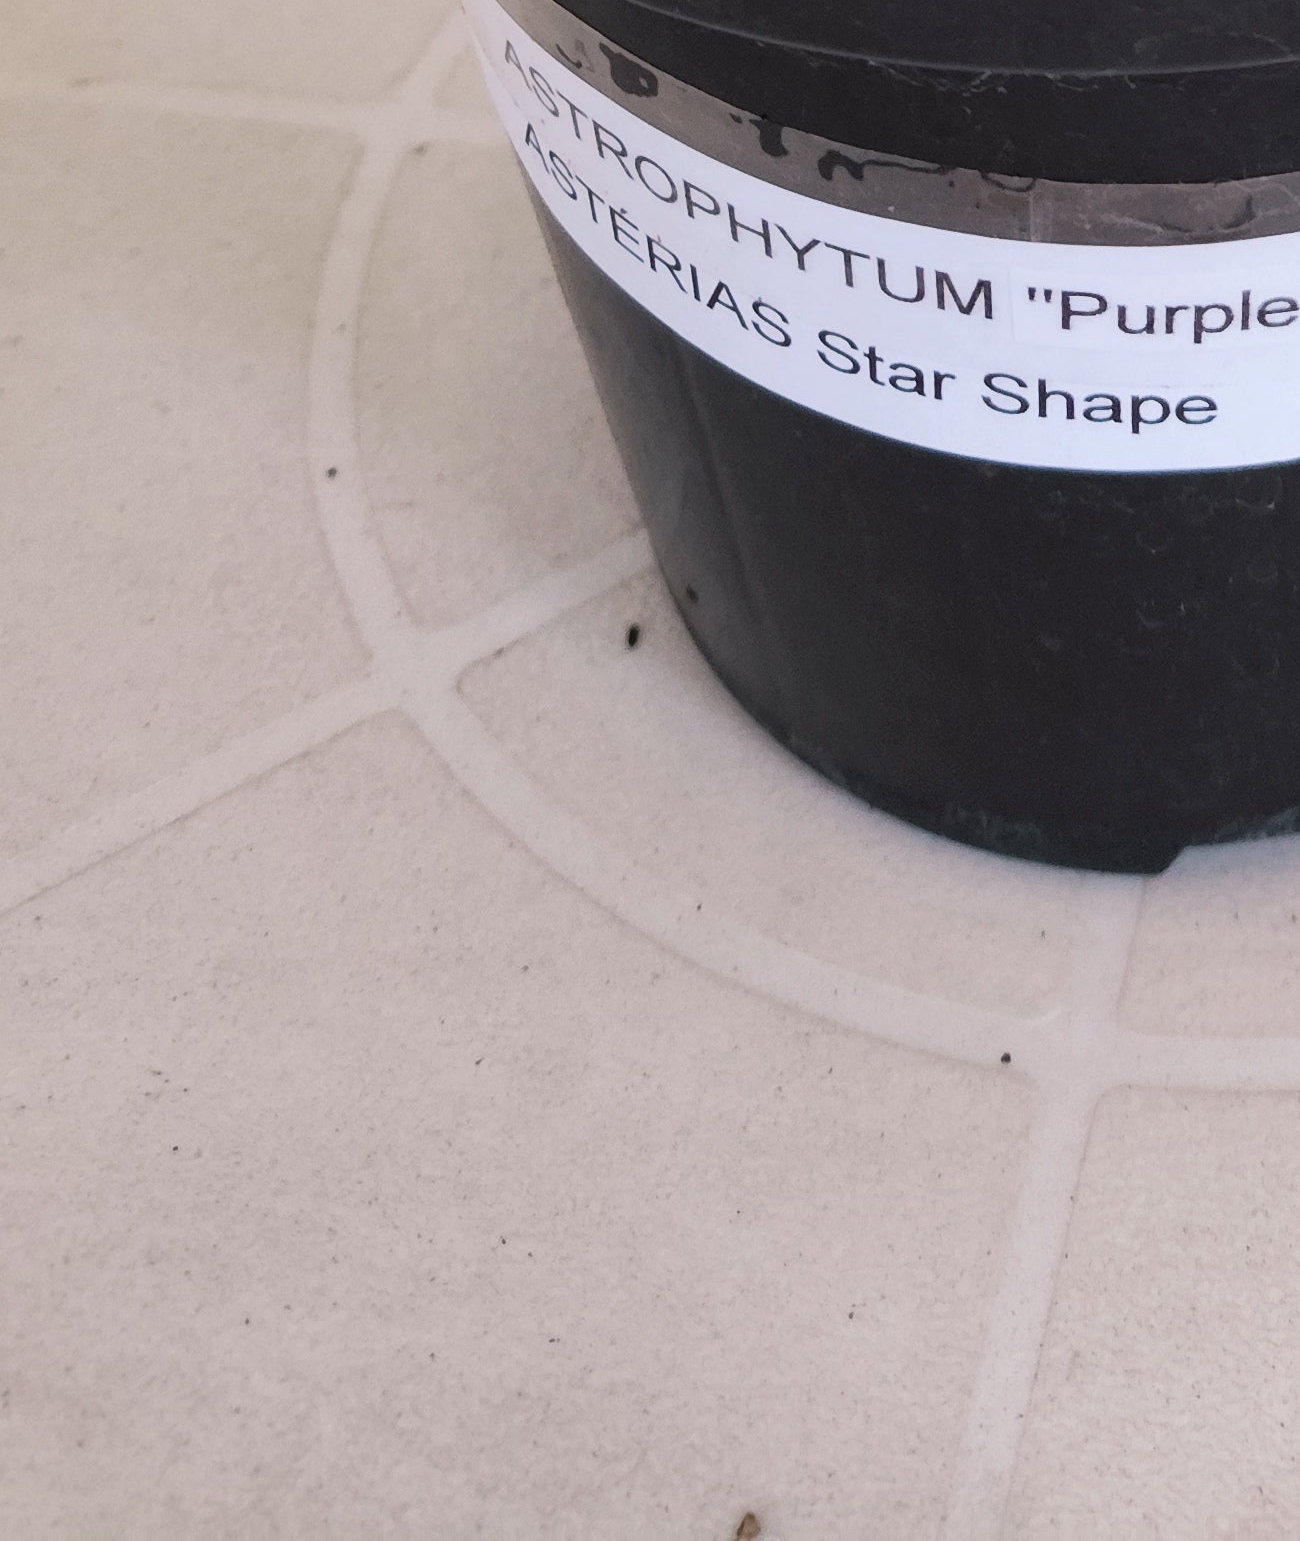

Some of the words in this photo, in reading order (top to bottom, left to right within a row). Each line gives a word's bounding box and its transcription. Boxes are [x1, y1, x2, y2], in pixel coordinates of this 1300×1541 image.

[504, 40, 994, 320] ASTROPHYTUM
[524, 121, 792, 348] ASTÉRIAS
[817, 329, 956, 401] Star
[981, 372, 1218, 433] Shape
